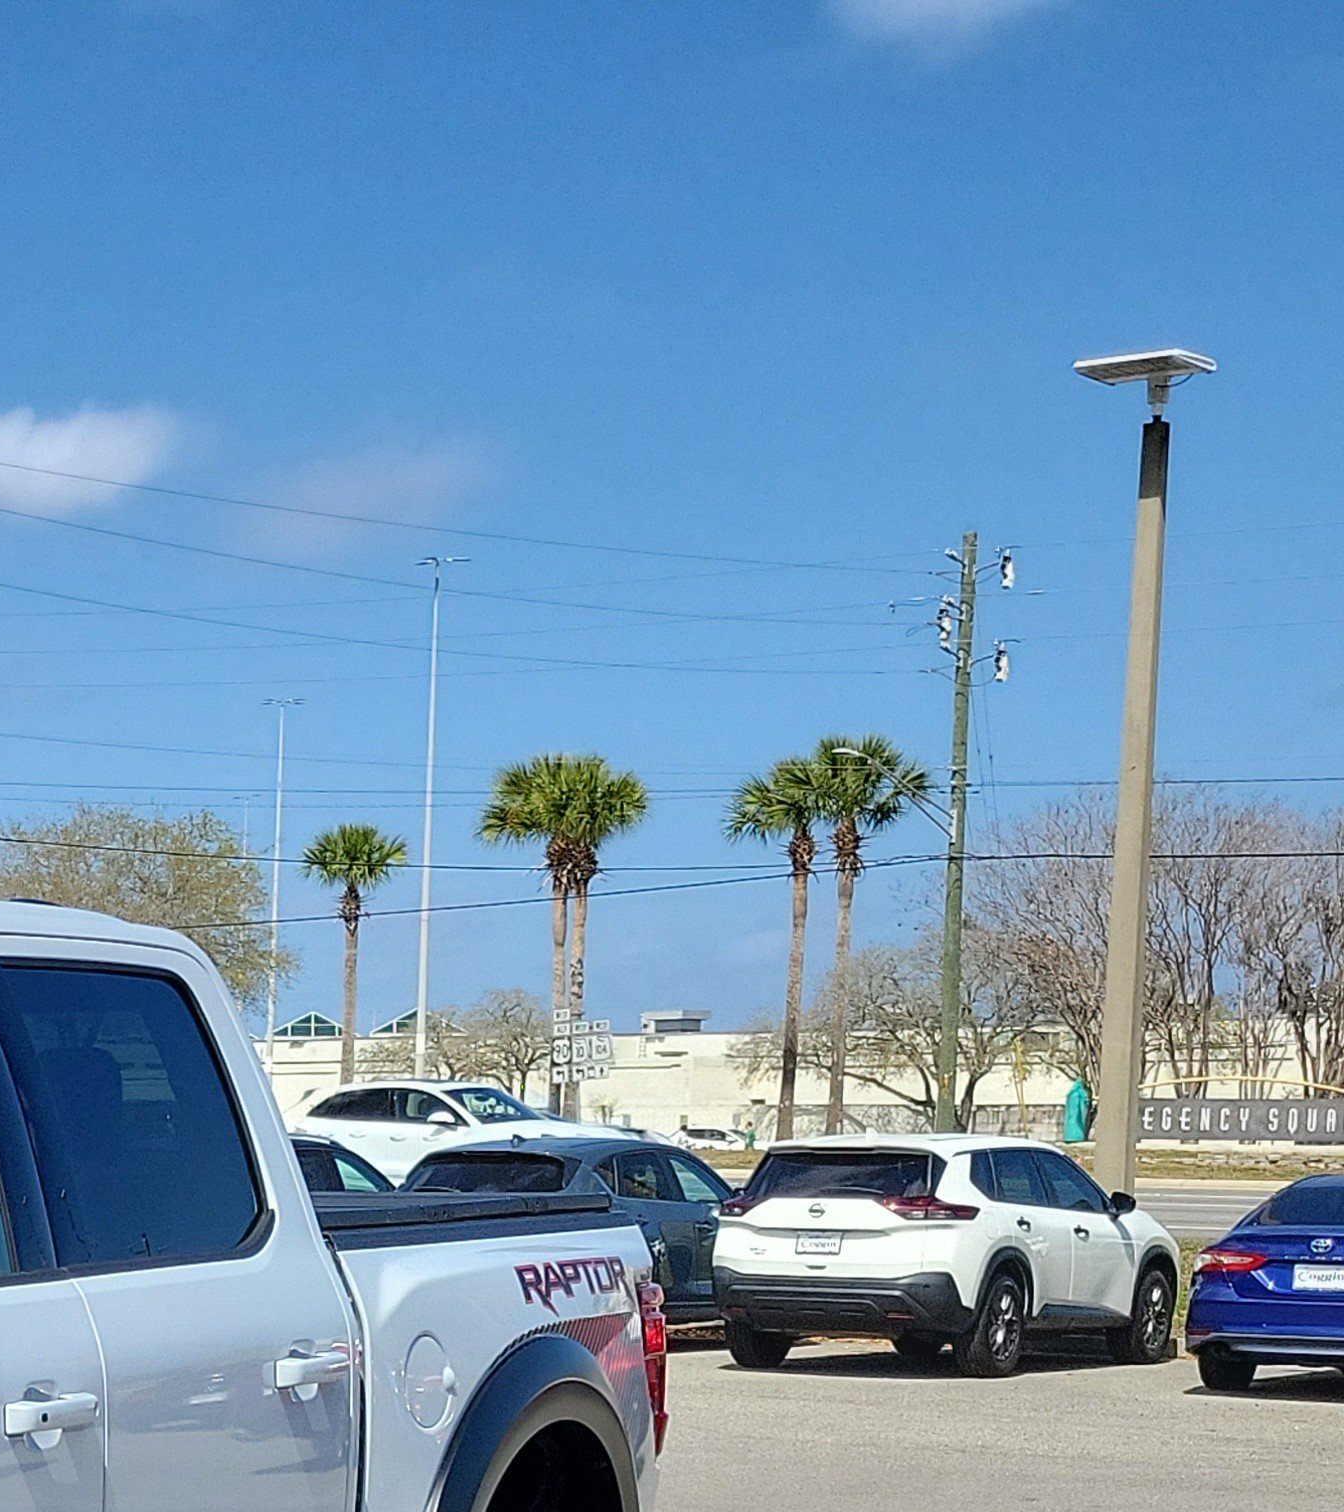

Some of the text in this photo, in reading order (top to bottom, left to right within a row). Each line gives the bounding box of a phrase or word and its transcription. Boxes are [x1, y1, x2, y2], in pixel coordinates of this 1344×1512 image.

[1142, 1106, 1344, 1135] EGENCY SQUA
[513, 1256, 635, 1318] RAPTOR
